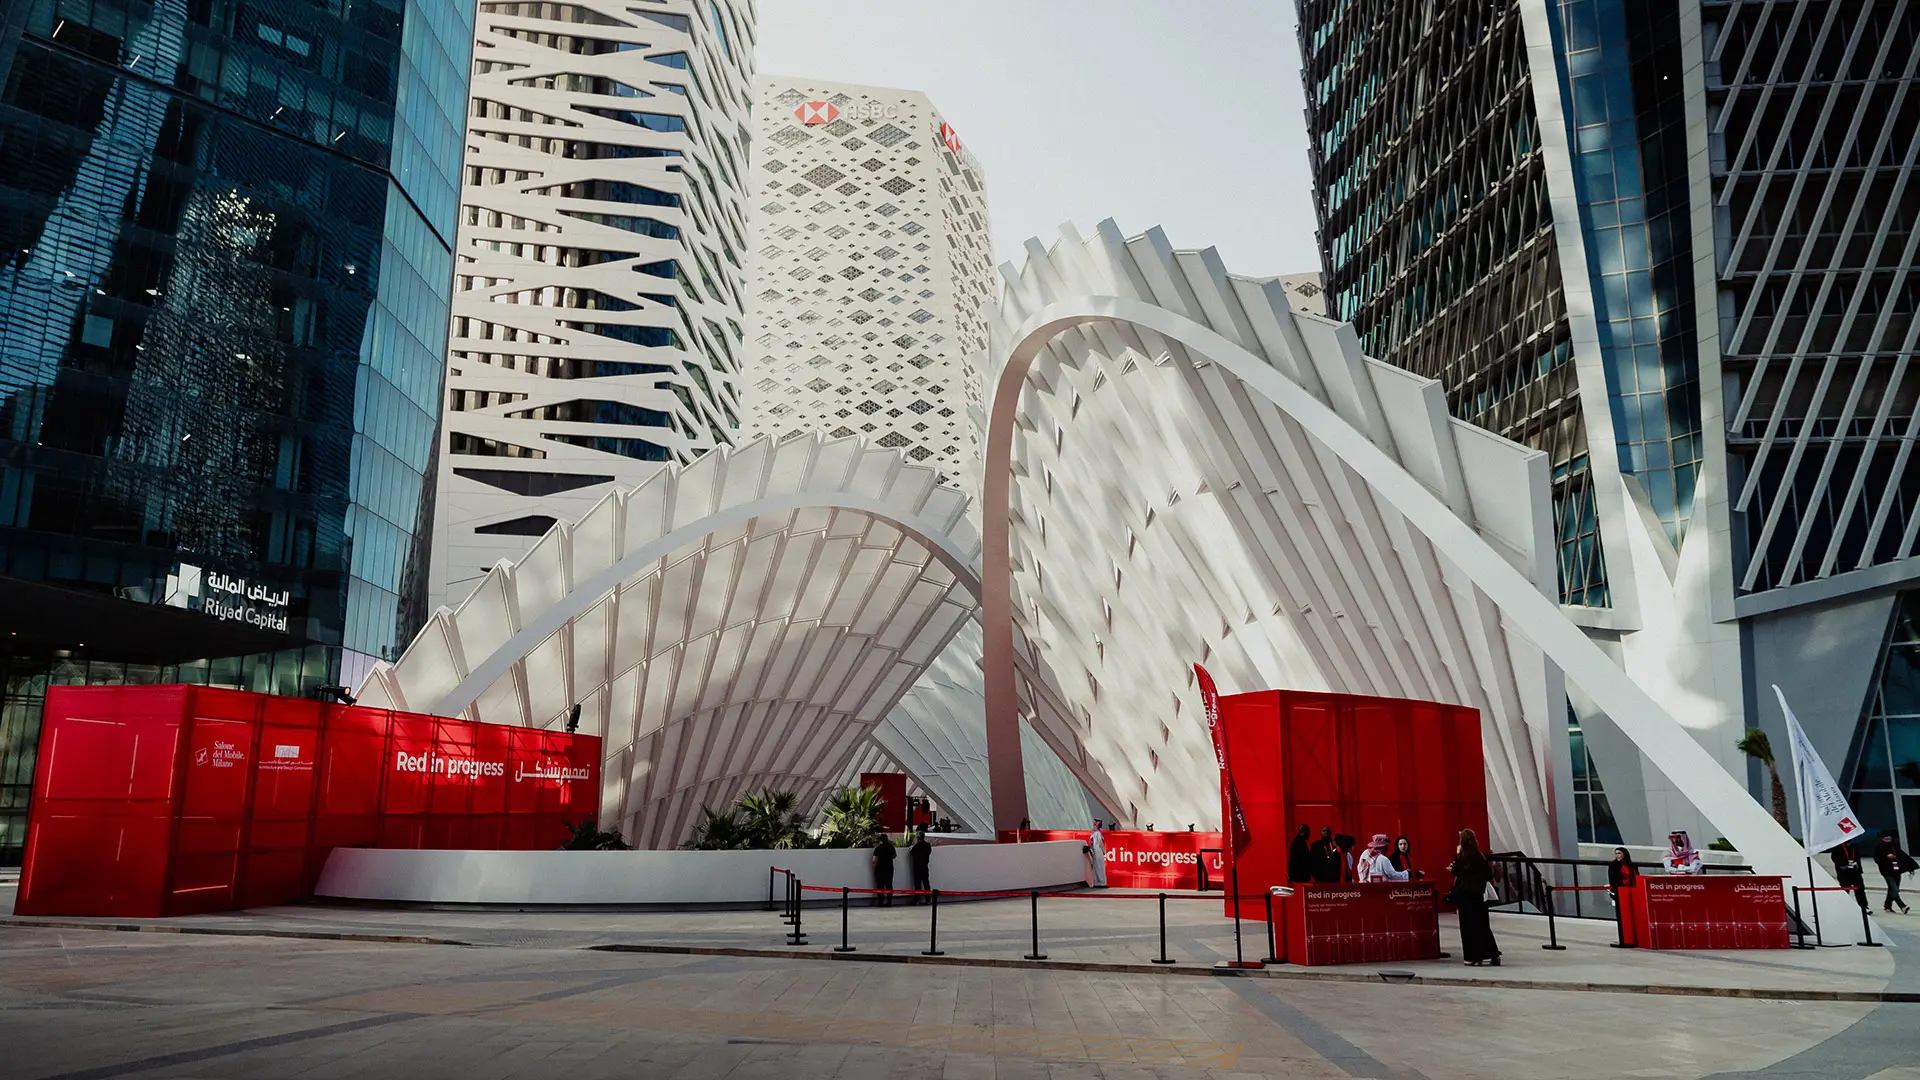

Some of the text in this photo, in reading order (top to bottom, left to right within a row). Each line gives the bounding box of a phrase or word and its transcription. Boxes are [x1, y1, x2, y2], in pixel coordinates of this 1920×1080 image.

[844, 105, 898, 119] HSBC
[207, 571, 290, 607] الرياض المالية
[205, 597, 287, 631] Riyad Capital
[214, 740, 235, 750] Salone
[212, 750, 223, 758] del
[212, 758, 234, 768] Milano
[396, 751, 505, 780] Red in progress
[515, 757, 590, 786] تصميم يتشكل
[1120, 846, 1133, 862] in
[1137, 851, 1197, 866] progress
[1413, 888, 1432, 899] تصميم
[1734, 883, 1781, 893] تصميم يتشكل
[1308, 890, 1361, 900] Red in progress
